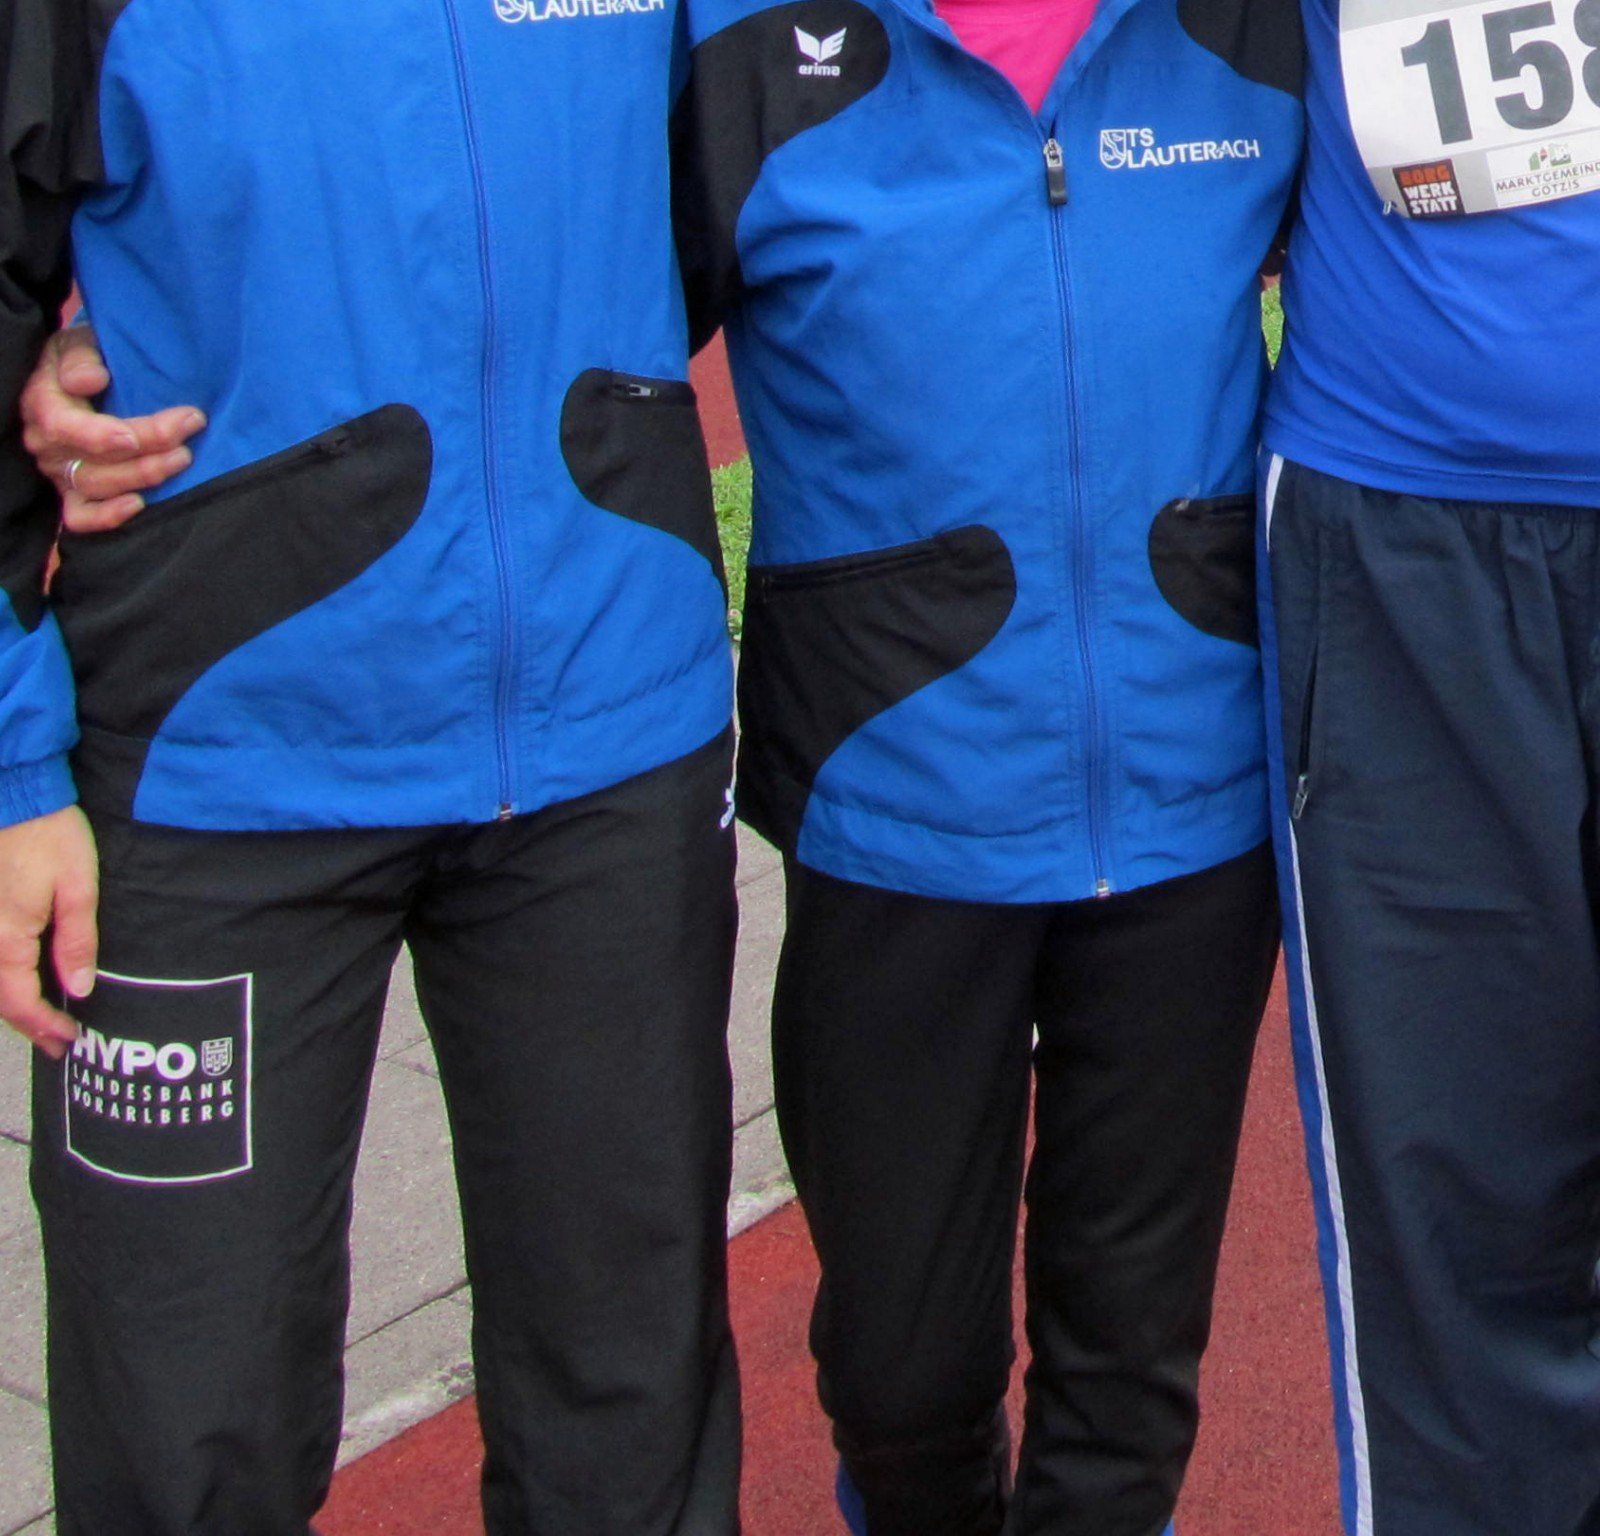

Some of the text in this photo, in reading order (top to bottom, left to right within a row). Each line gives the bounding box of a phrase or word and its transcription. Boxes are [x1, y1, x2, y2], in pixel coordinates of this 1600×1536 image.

[798, 62, 841, 77] erima
[1126, 128, 1155, 148] TS
[1127, 139, 1261, 169] LAUTERACH
[1403, 181, 1455, 200] WERK
[1410, 196, 1458, 215] STATT
[73, 1022, 197, 1081] HYPO
[73, 1062, 234, 1103] LANDESBANK
[73, 1084, 234, 1125] VORARLBERG
